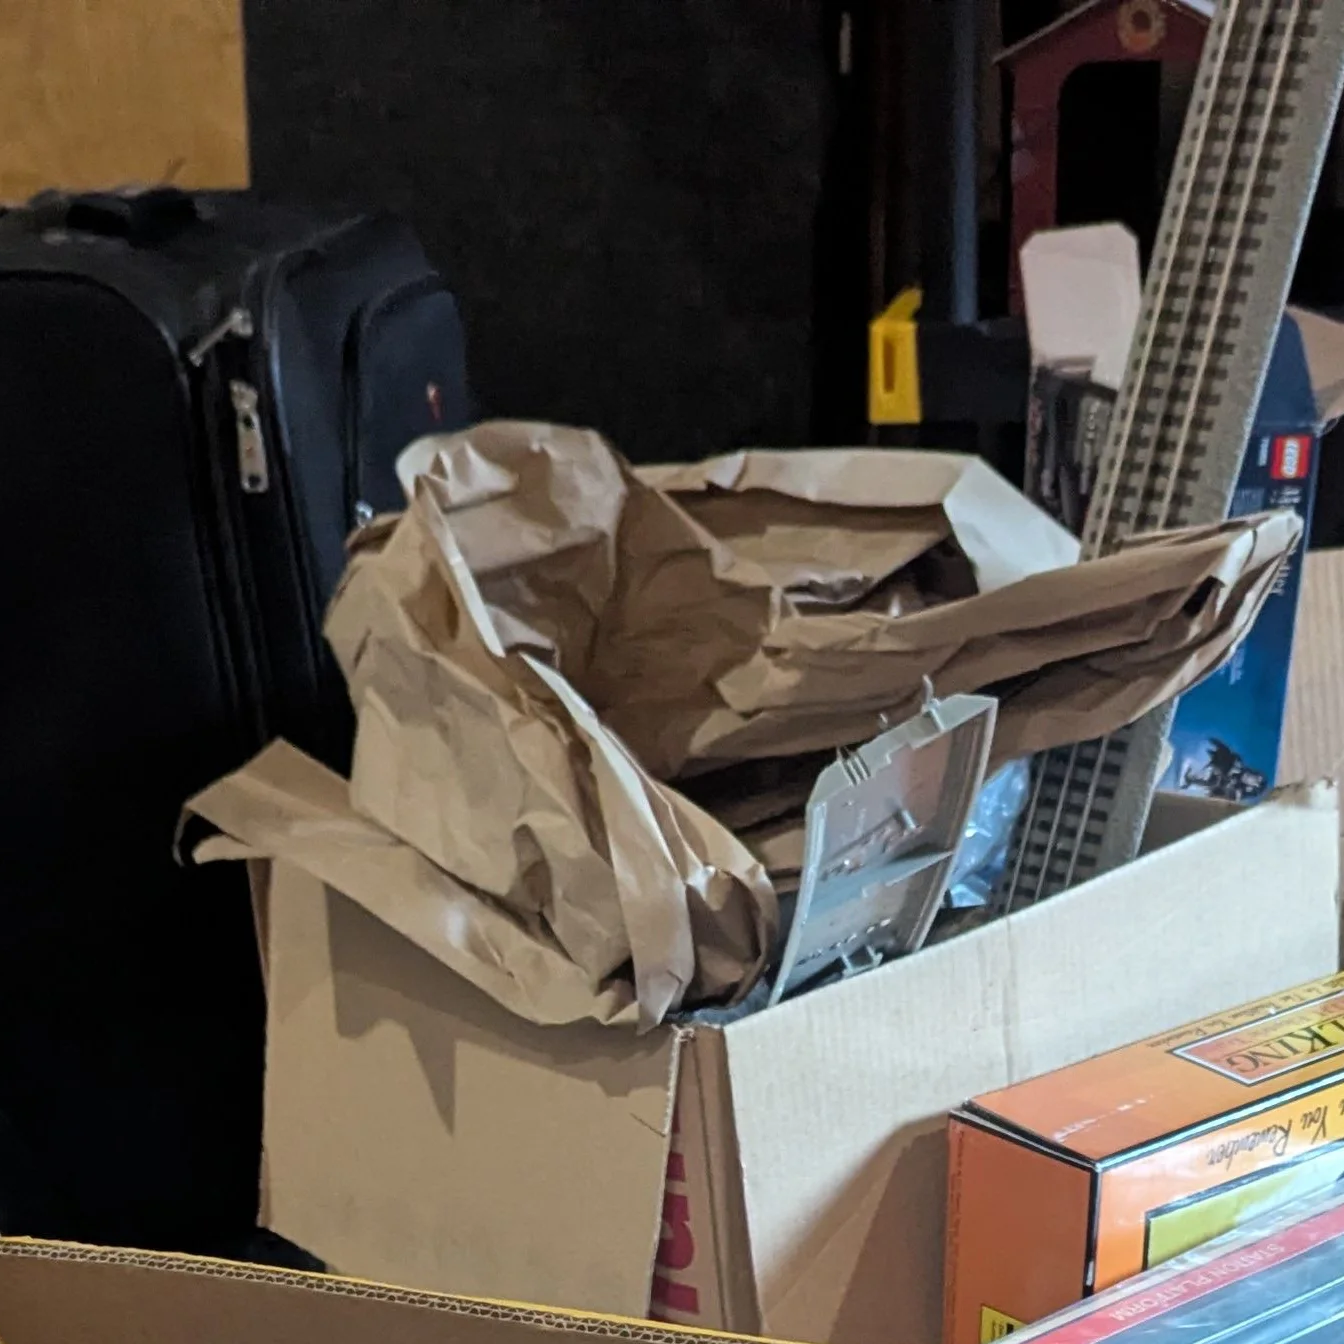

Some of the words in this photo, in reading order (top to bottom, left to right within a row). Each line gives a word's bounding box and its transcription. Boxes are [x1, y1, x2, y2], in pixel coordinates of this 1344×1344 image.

[1206, 1119, 1293, 1172] Remember
[1300, 1107, 1328, 1145] You
[1212, 1243, 1286, 1278] STATION
[1108, 1274, 1213, 1322] PLATFORM
